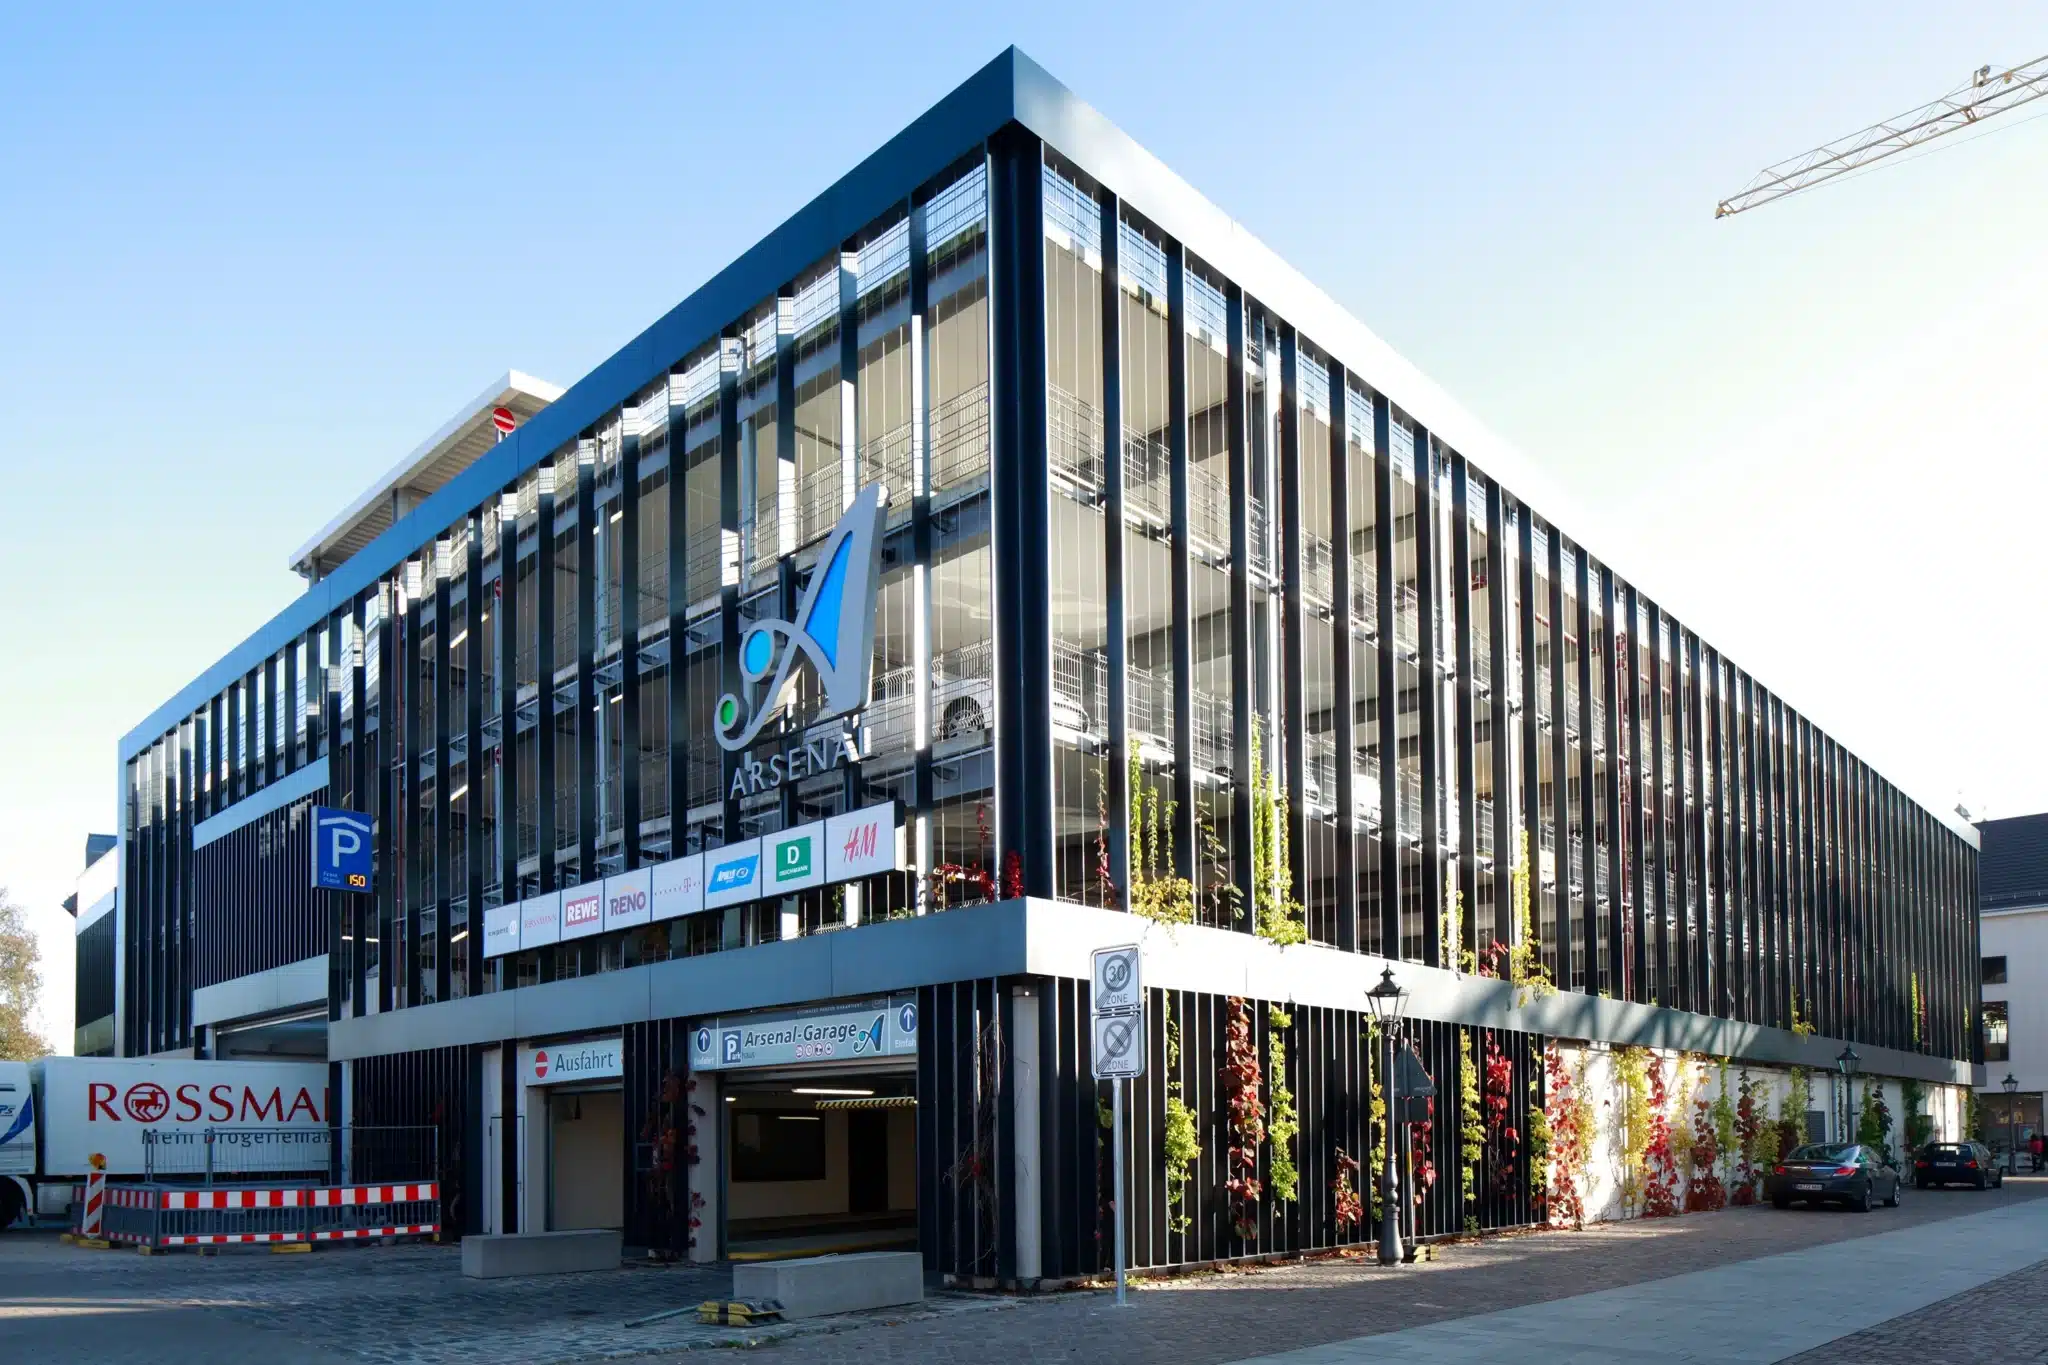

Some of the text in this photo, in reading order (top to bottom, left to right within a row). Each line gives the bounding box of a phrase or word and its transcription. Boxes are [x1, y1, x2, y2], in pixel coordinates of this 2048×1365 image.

[730, 726, 873, 800] ARSENAL
[332, 827, 361, 868] P
[787, 845, 800, 864] D
[567, 899, 598, 922] REWE
[610, 891, 647, 916] RENO
[1108, 964, 1126, 983] 30
[1106, 993, 1129, 1004] ZONE
[744, 1023, 857, 1047] Arsenal-Garage
[894, 1037, 917, 1048] Einfah
[555, 1050, 613, 1073] Ausfahrt
[1107, 1060, 1129, 1070] ZONE
[142, 1128, 194, 1145] Mein
